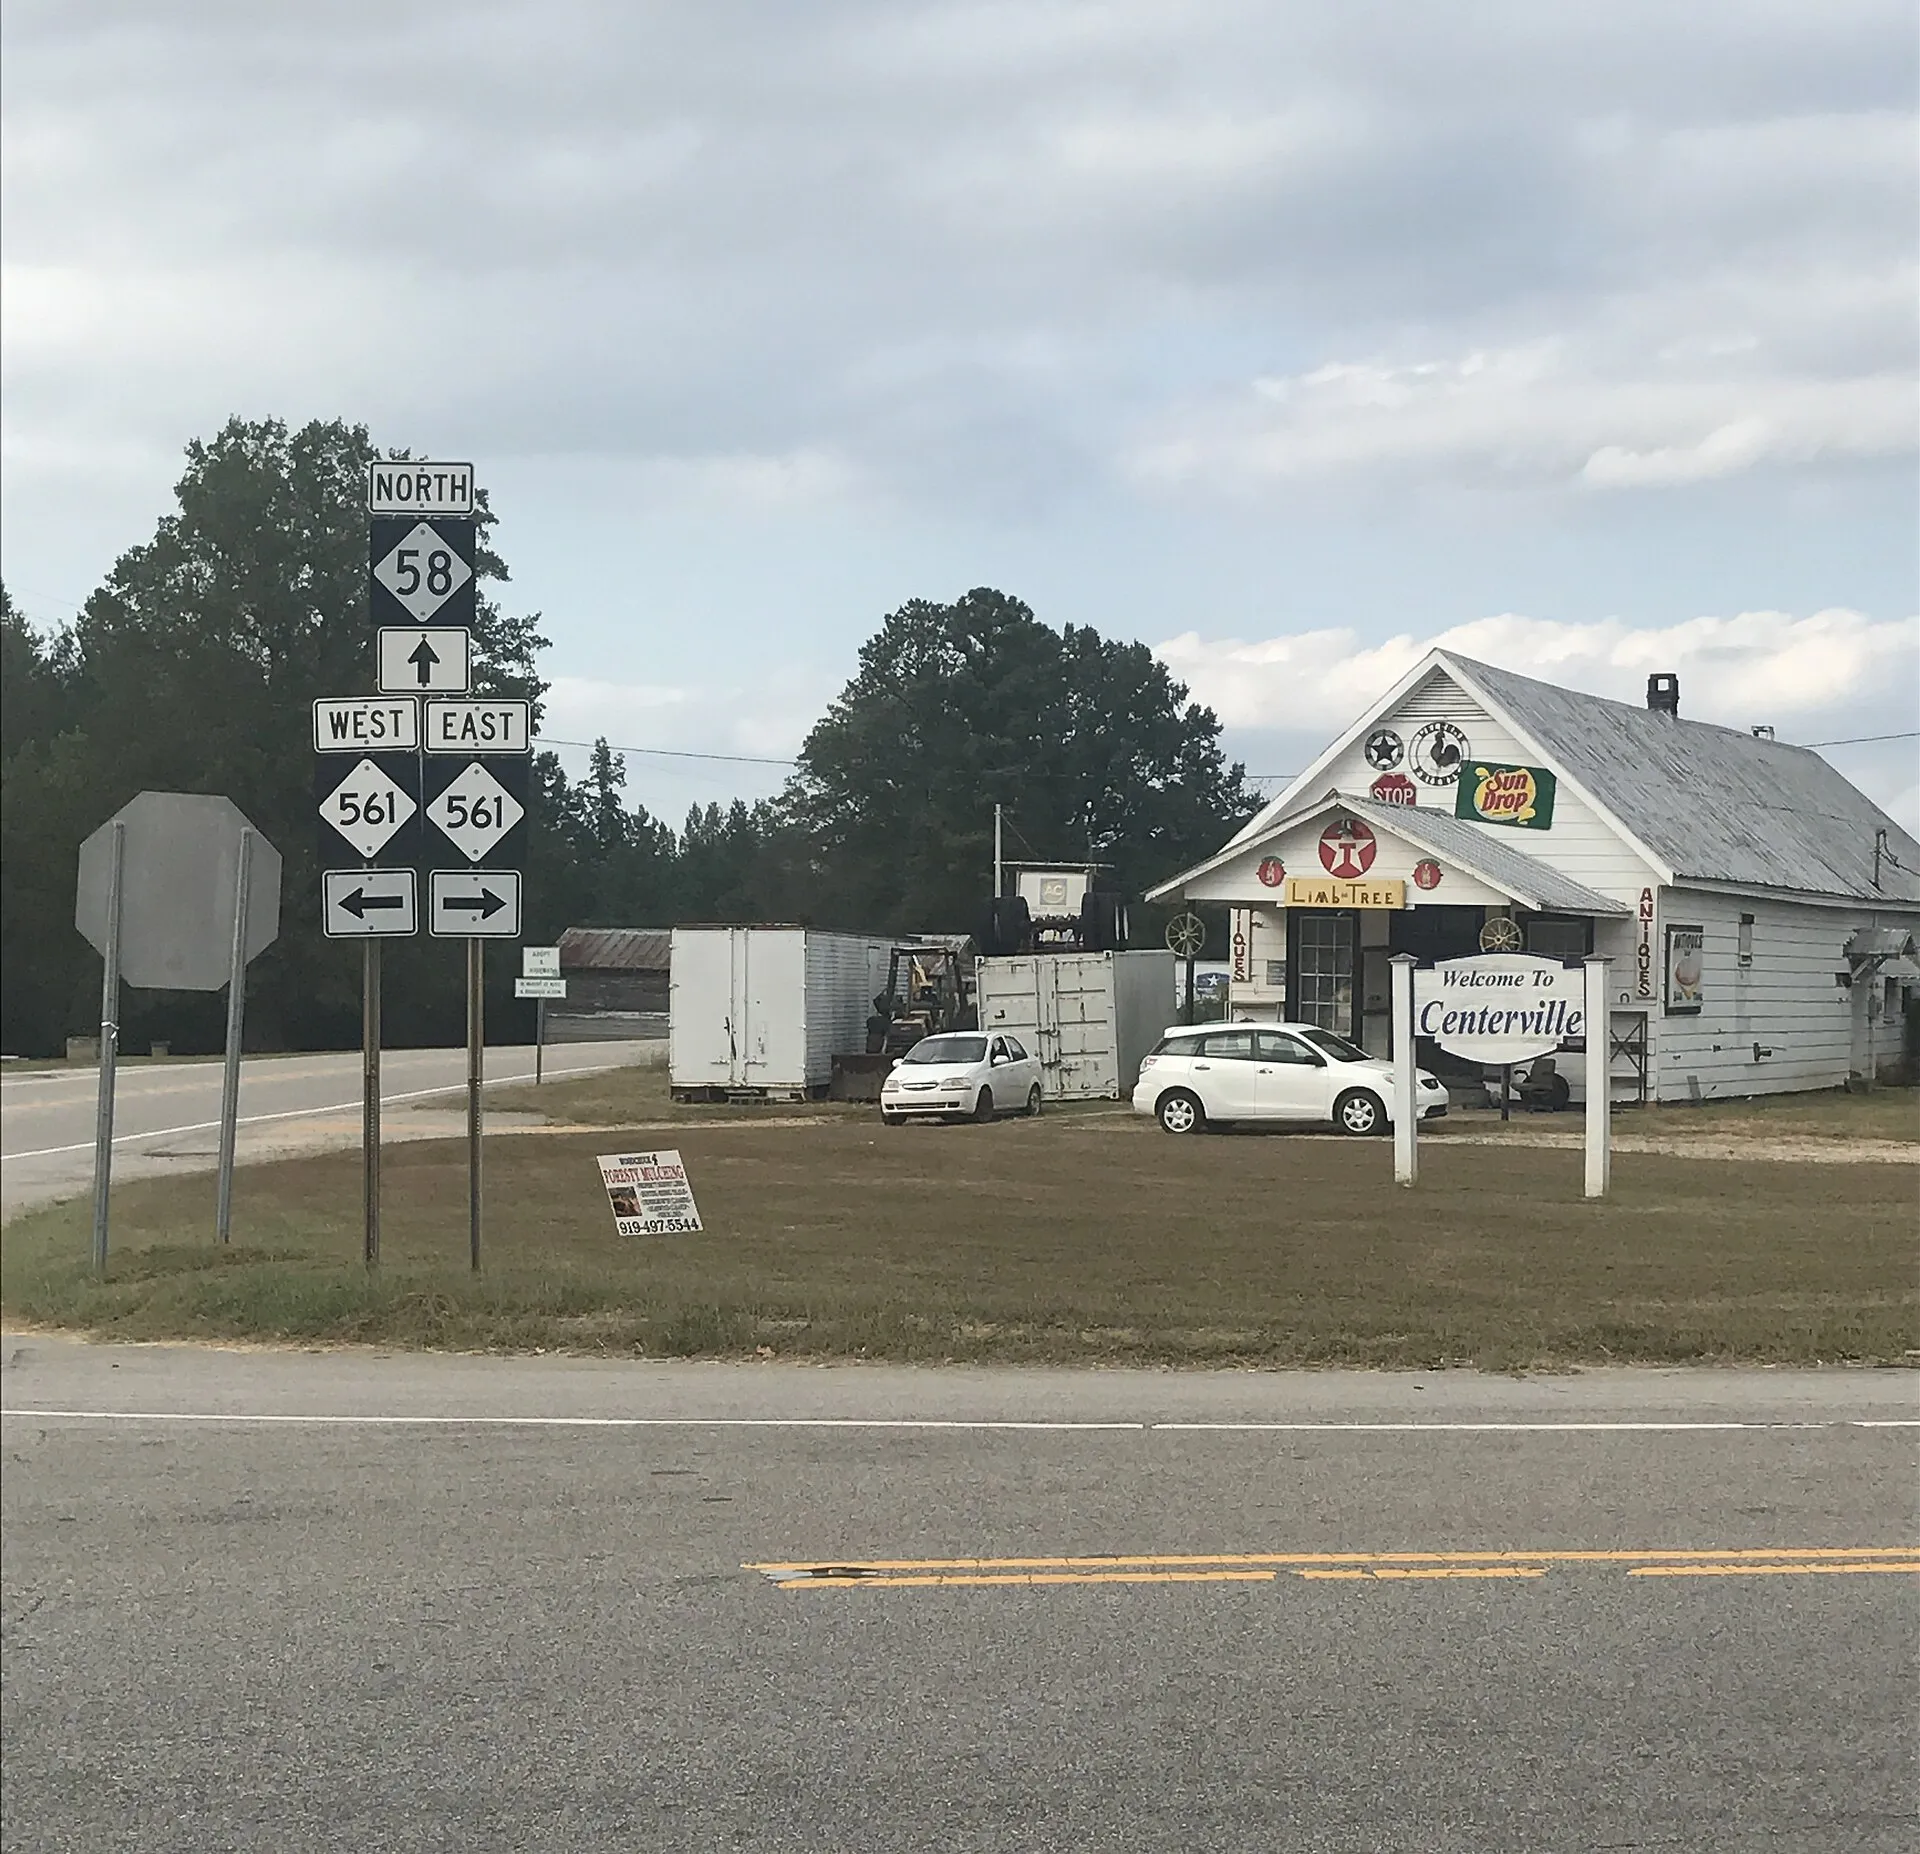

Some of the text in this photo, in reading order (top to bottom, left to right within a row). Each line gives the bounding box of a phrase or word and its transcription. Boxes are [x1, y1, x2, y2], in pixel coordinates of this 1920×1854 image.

[377, 473, 467, 502] NORTH
[396, 549, 453, 596] 58
[329, 709, 404, 739] WEST
[442, 712, 514, 741] EAST
[1485, 770, 1528, 792] Sun
[339, 791, 396, 826] 561
[1374, 788, 1414, 805] STOP
[1481, 792, 1528, 812] Drop
[446, 796, 503, 829] 561
[1638, 887, 1654, 996] ANTIQUES
[1443, 969, 1555, 987] Welcome To
[1420, 1000, 1582, 1036] Centerville
[619, 1218, 699, 1234] 919-497-5544
